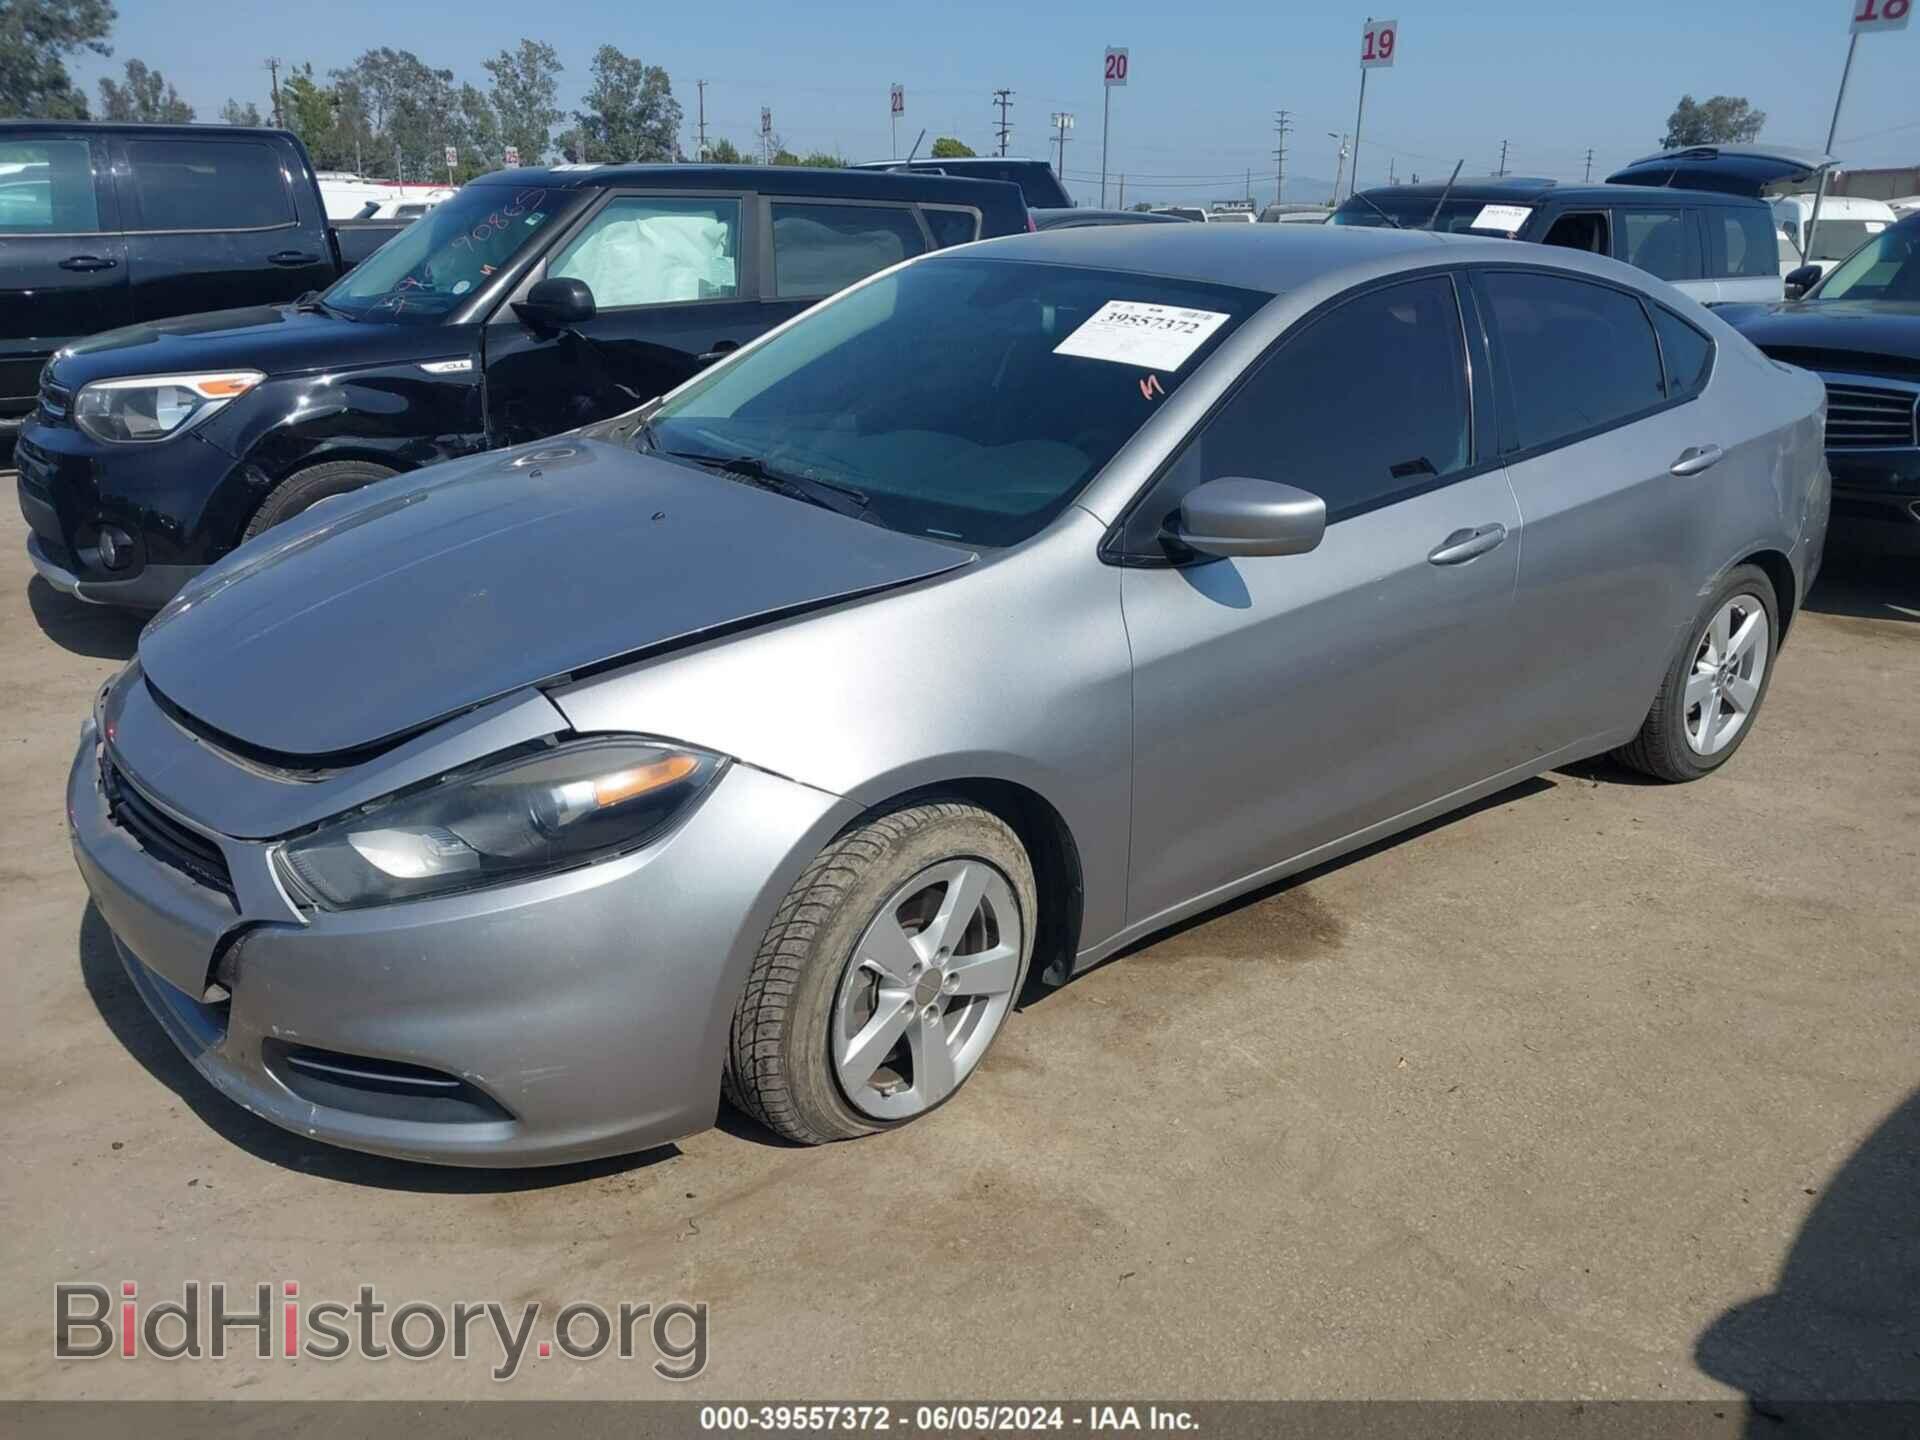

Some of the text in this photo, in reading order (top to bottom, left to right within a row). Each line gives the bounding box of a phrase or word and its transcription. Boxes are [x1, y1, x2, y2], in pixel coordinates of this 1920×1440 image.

[1362, 29, 1394, 60] 19
[1105, 54, 1127, 79] 20
[891, 92, 904, 112] 21
[1100, 312, 1200, 334] 39557372
